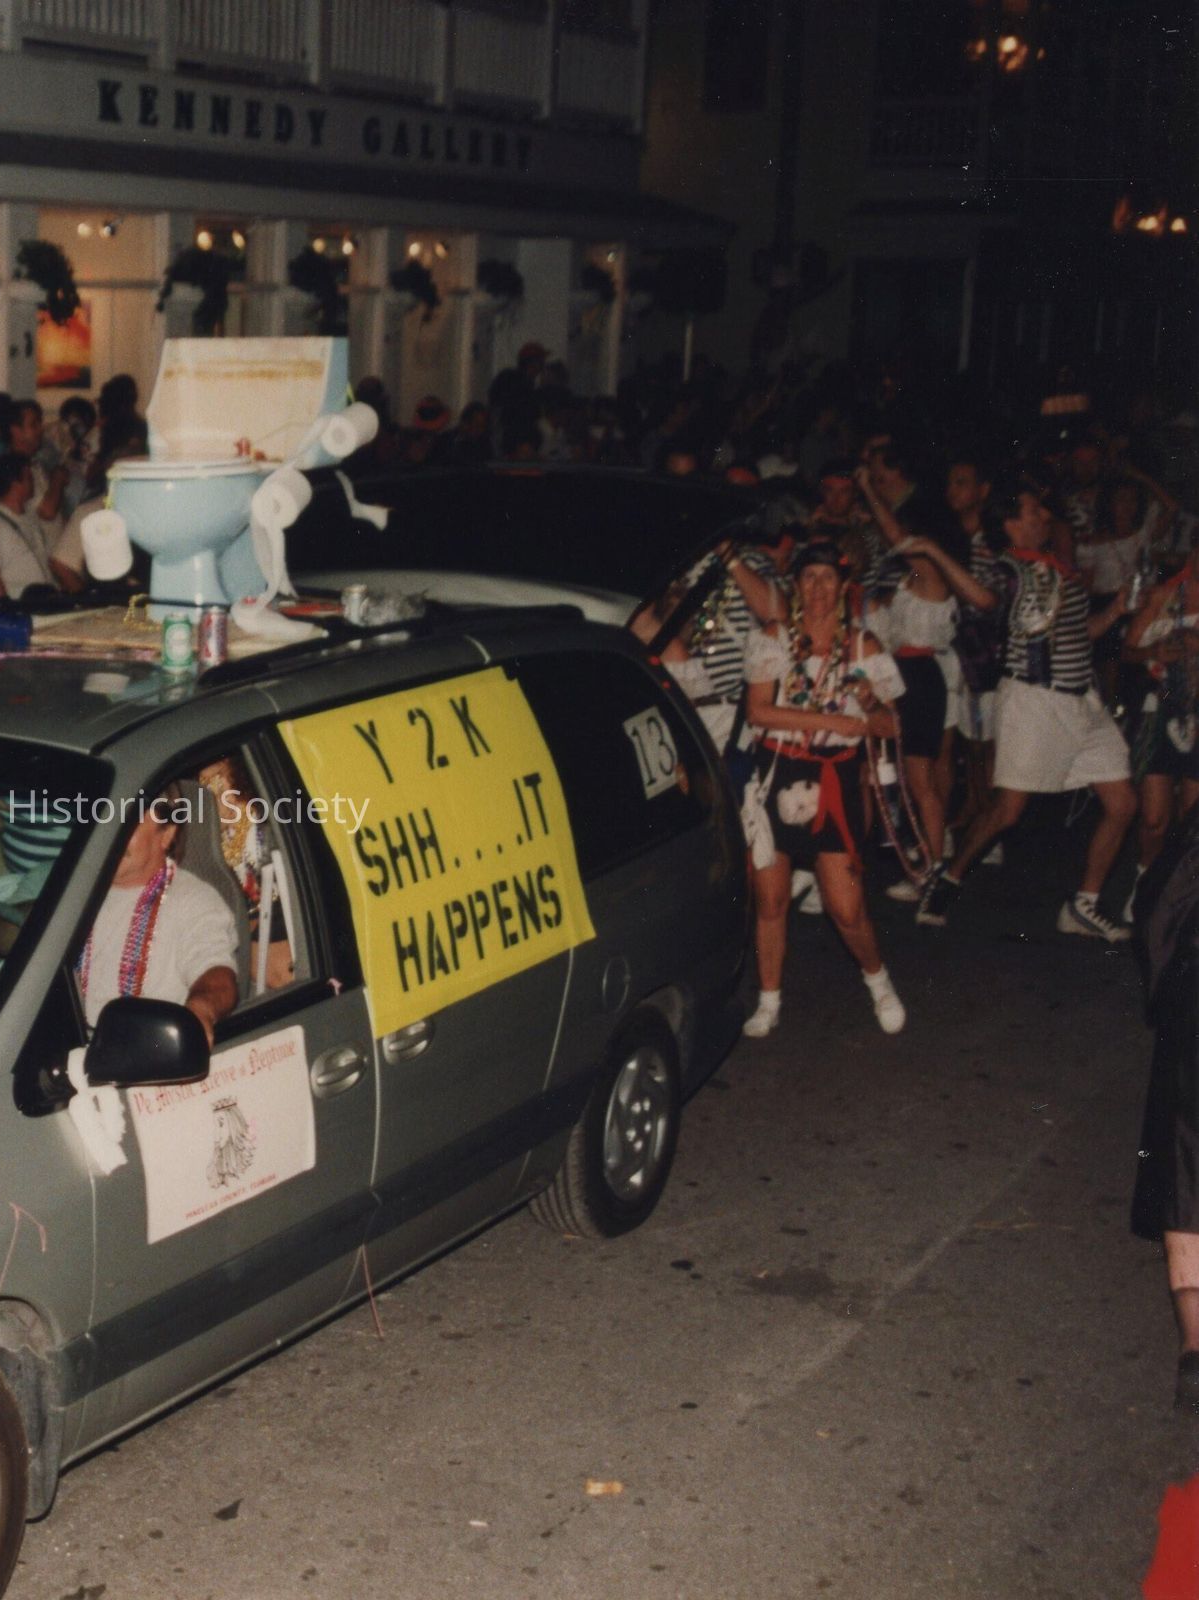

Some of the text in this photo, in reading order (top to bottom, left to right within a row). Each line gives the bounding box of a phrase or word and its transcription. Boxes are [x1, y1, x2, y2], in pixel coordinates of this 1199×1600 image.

[97, 78, 533, 171] KENNEDY GALLERY
[353, 694, 493, 785] Y 2 K
[629, 713, 678, 788] 13
[392, 863, 564, 993] HAPPENS
